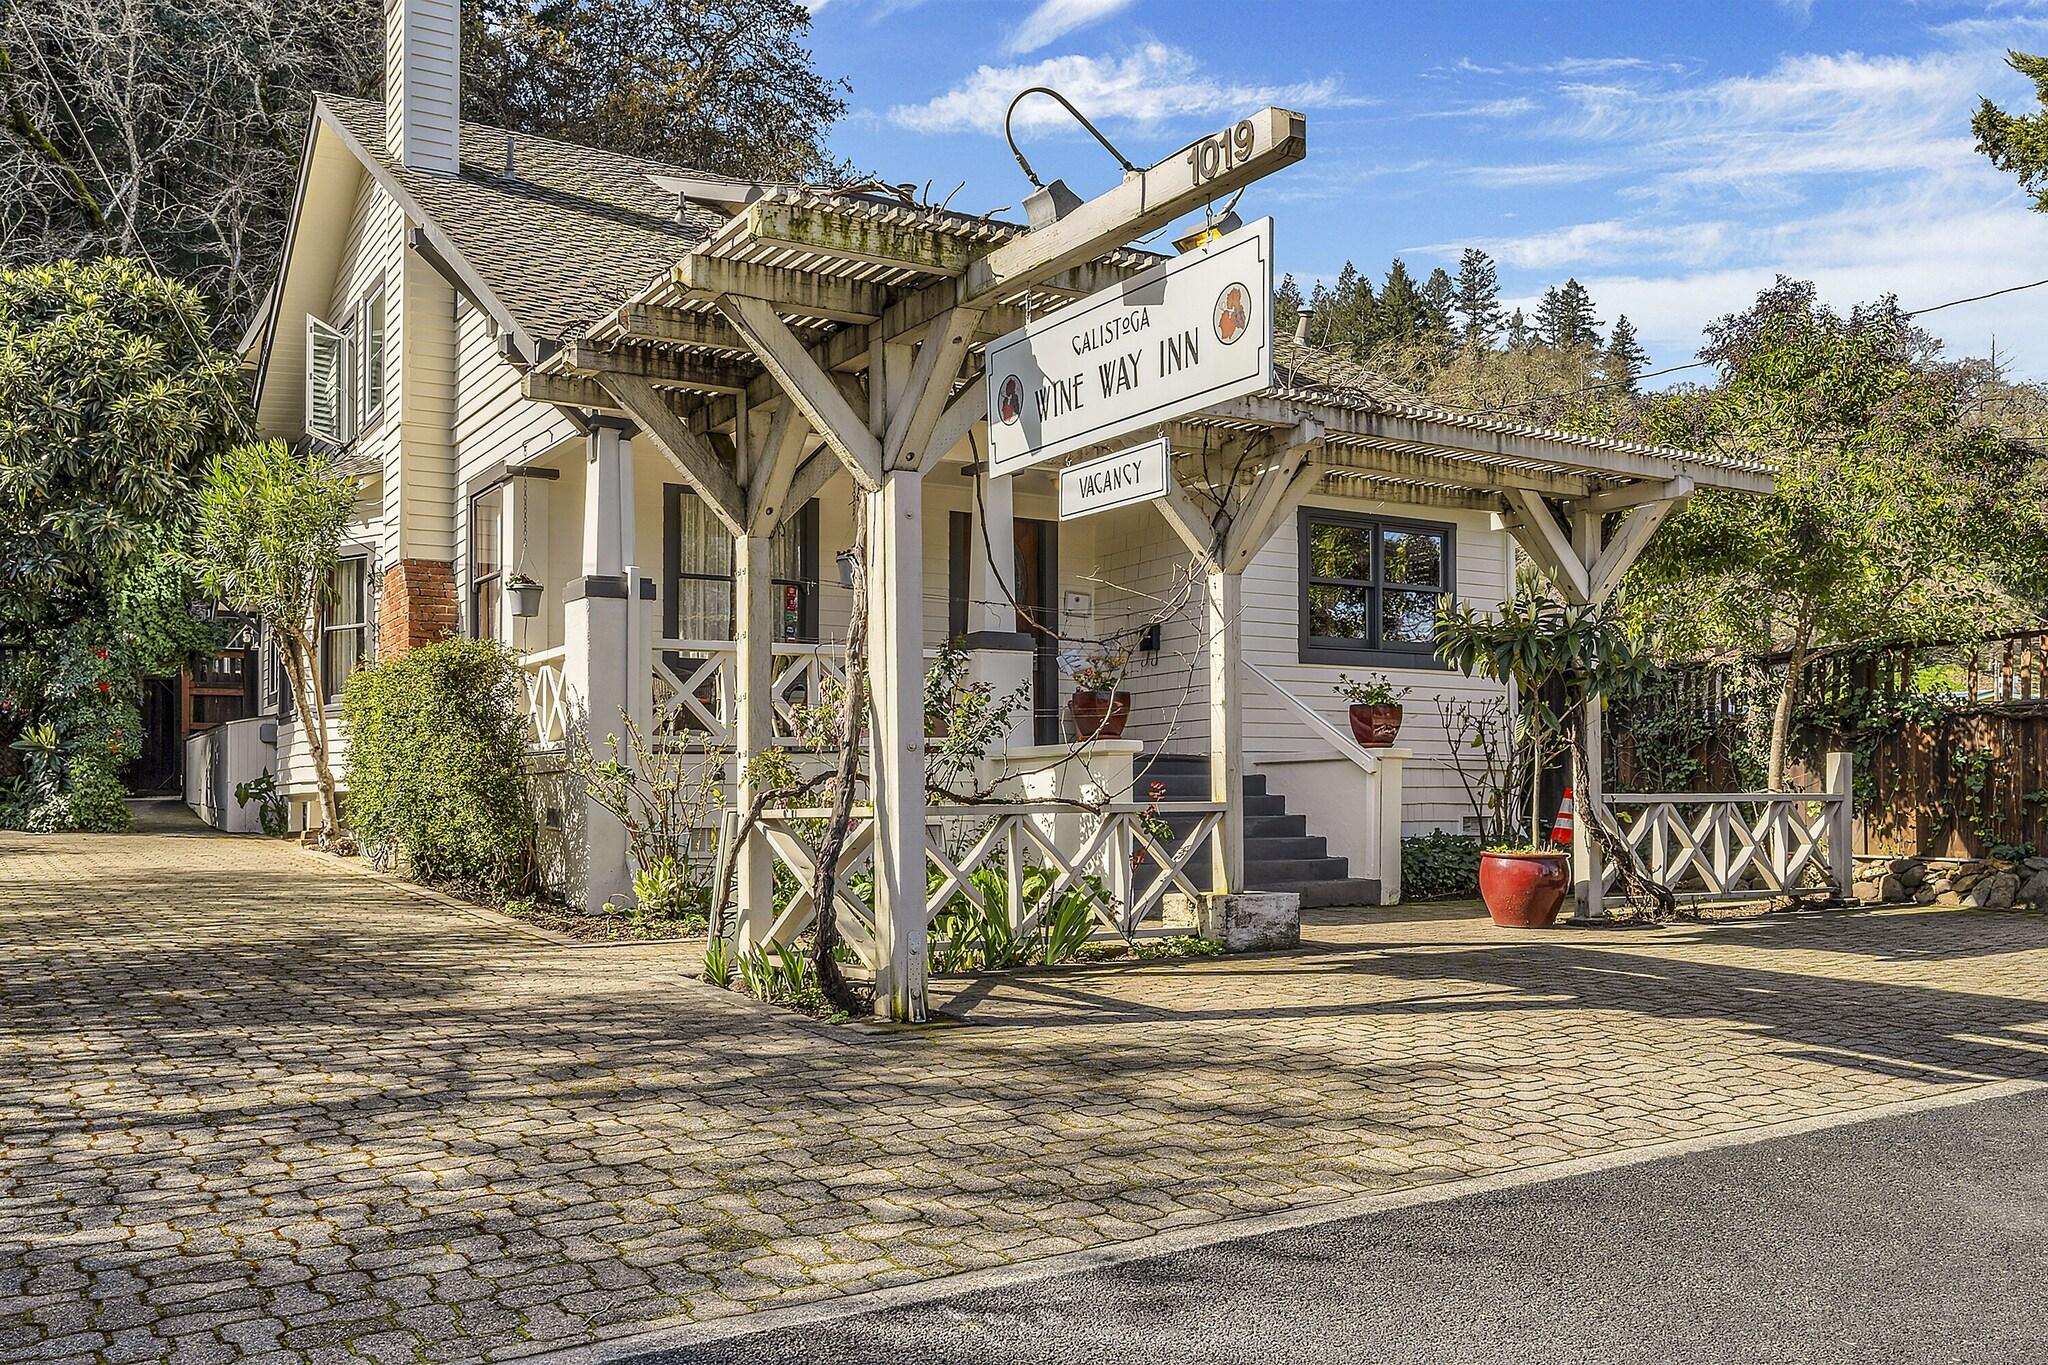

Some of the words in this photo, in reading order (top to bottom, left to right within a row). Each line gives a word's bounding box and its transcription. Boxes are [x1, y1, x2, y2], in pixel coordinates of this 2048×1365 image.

[1187, 120, 1254, 186] 1019
[1034, 373, 1084, 423] WINE
[1098, 349, 1143, 399] WAY
[1160, 327, 1199, 378] INN
[1079, 460, 1142, 499] VACANCY
